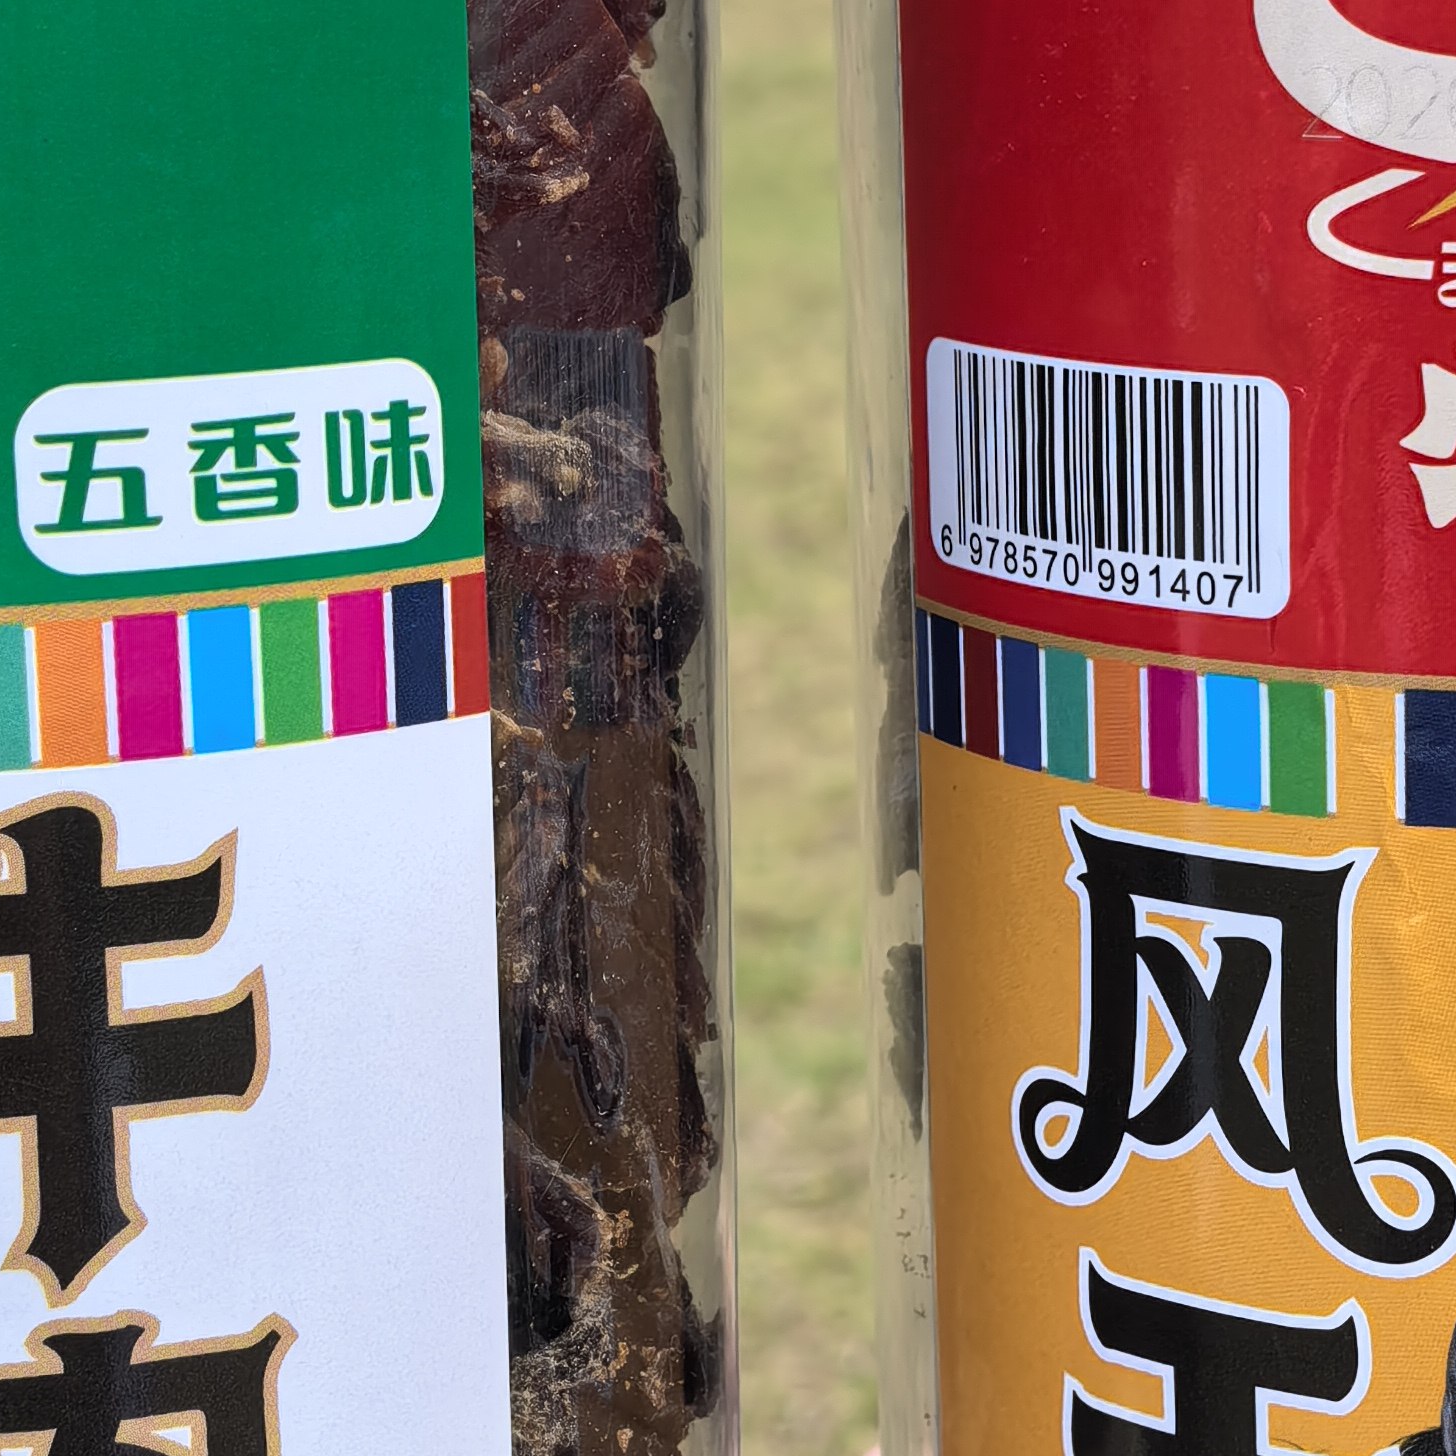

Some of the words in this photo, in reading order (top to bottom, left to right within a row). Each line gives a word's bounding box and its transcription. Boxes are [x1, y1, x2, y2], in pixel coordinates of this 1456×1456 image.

[33, 399, 435, 536] 五香味
[940, 524, 954, 557] 6
[969, 532, 1080, 587] 978570
[1097, 558, 1244, 609] 991407
